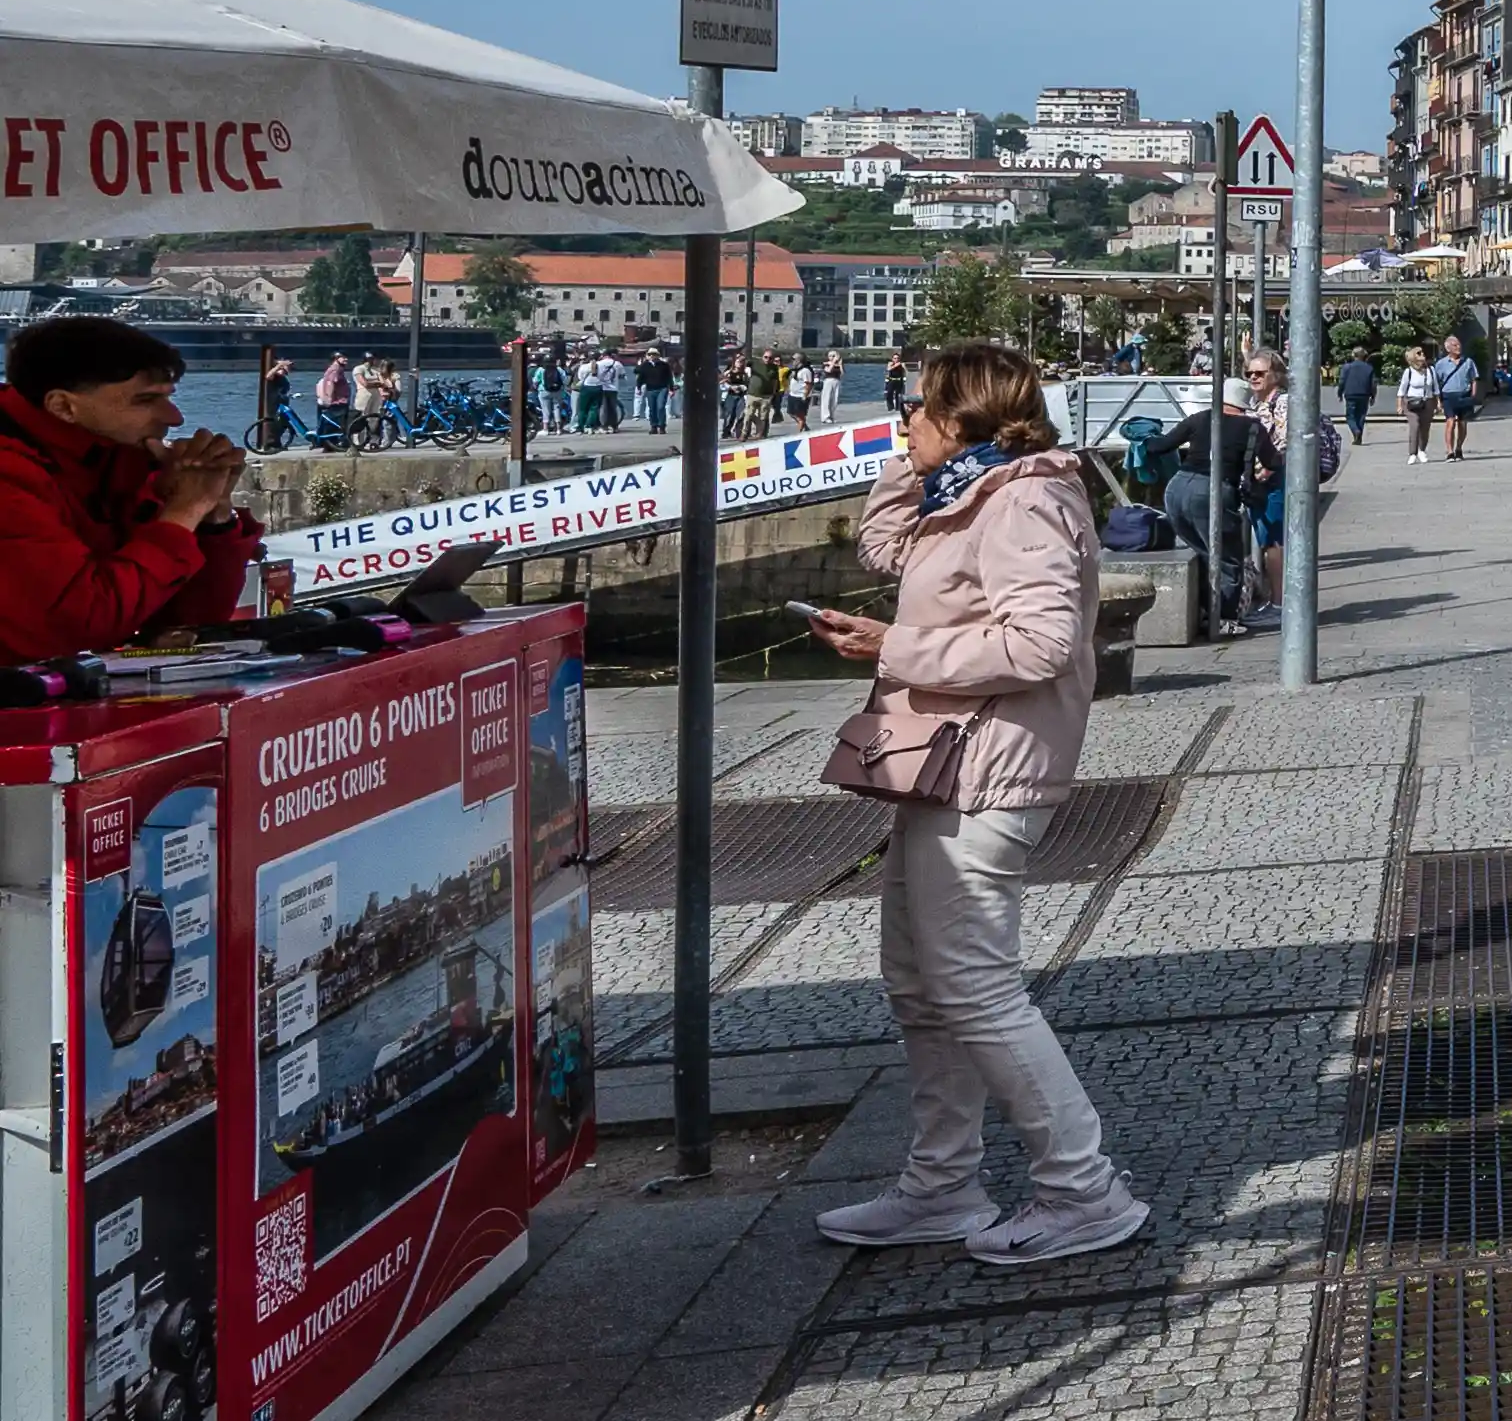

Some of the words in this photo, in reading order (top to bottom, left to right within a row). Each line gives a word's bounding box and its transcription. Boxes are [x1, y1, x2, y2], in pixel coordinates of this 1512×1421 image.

[999, 156, 1103, 170] GRAHAM'S
[1246, 204, 1278, 216] RSU
[724, 473, 813, 504] DOURO
[307, 522, 376, 553] THE
[391, 484, 572, 536] QUICKEST
[587, 466, 663, 498] WAY
[552, 498, 658, 537] RIVER
[471, 681, 508, 718] TICKET
[258, 712, 364, 787] CRUZEIRO
[369, 705, 382, 748] 6
[388, 681, 456, 742] PONTES
[471, 718, 509, 755] OFFICE
[259, 800, 270, 833] 6
[275, 773, 337, 828] BRIDGES
[341, 757, 387, 800] CRUISE
[92, 810, 125, 834] TICKET
[92, 830, 125, 854] OFFICE
[251, 1236, 412, 1386] WWW.TICKETOFFICE.PT
